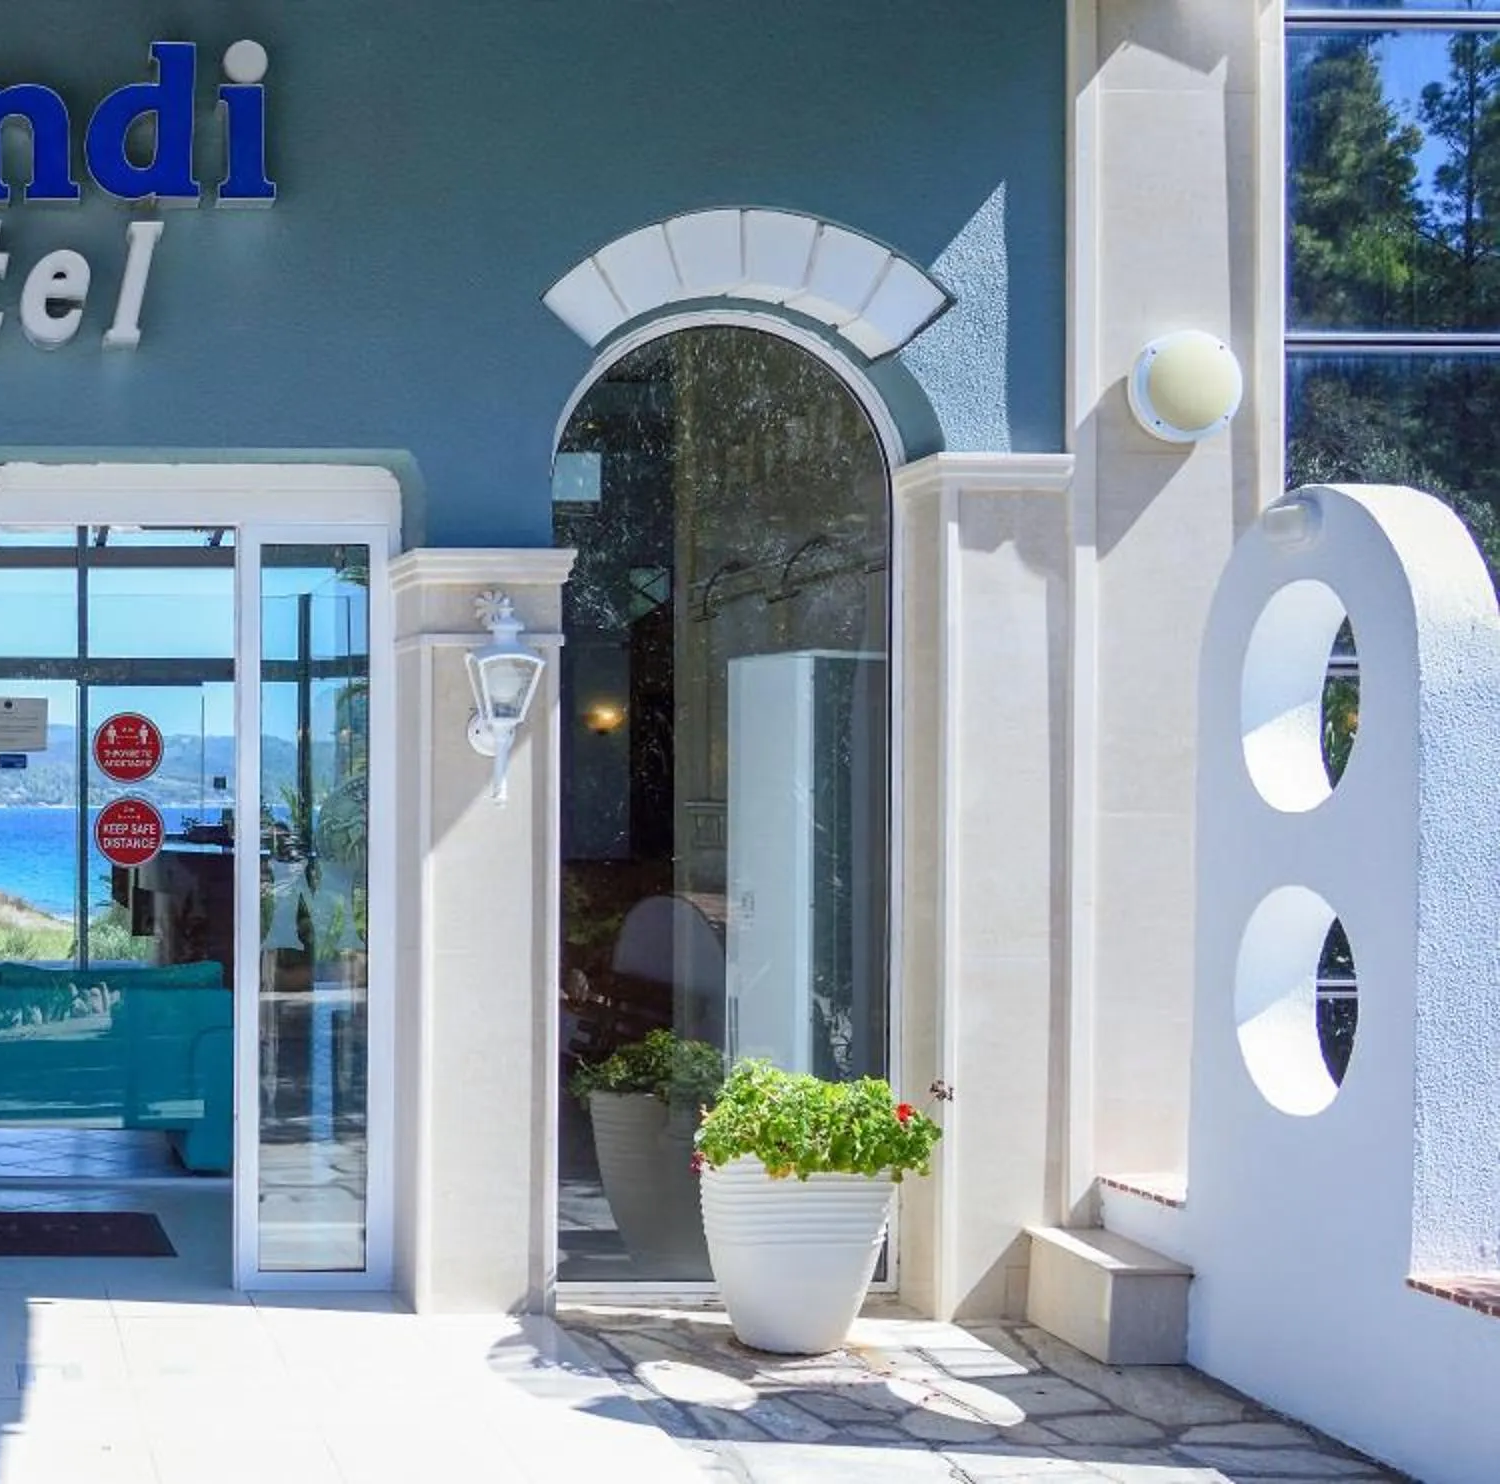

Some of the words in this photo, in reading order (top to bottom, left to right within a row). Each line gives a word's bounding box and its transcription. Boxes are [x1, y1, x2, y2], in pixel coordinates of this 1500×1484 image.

[103, 823, 129, 835] KEEP
[131, 823, 157, 835] SAFE
[103, 837, 157, 849] DISTANCE
